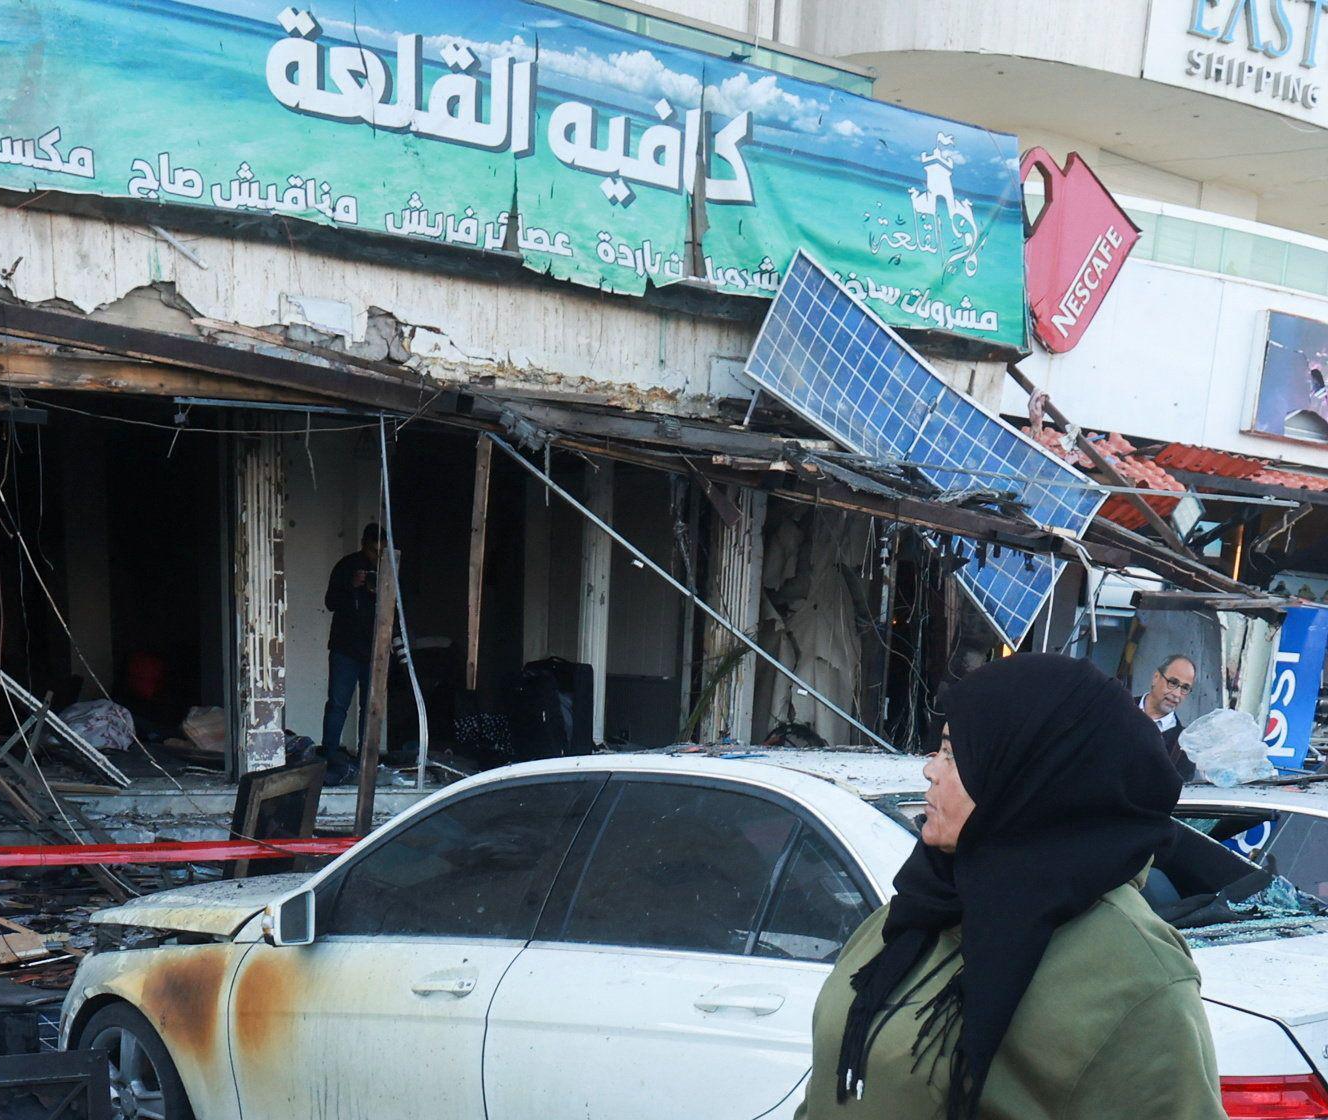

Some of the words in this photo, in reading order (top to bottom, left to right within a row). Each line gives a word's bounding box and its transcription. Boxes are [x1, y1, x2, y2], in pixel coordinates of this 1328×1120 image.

[265, 6, 536, 158] القلعة
[1185, 48, 1320, 109] SHIPPING
[129, 153, 203, 199] صاج
[548, 98, 756, 208] كافيه
[211, 162, 357, 224] مناقيش
[385, 191, 478, 244] فريش
[483, 211, 573, 257] عصائر
[596, 230, 662, 277] باردة
[900, 287, 998, 332] مشروبات
